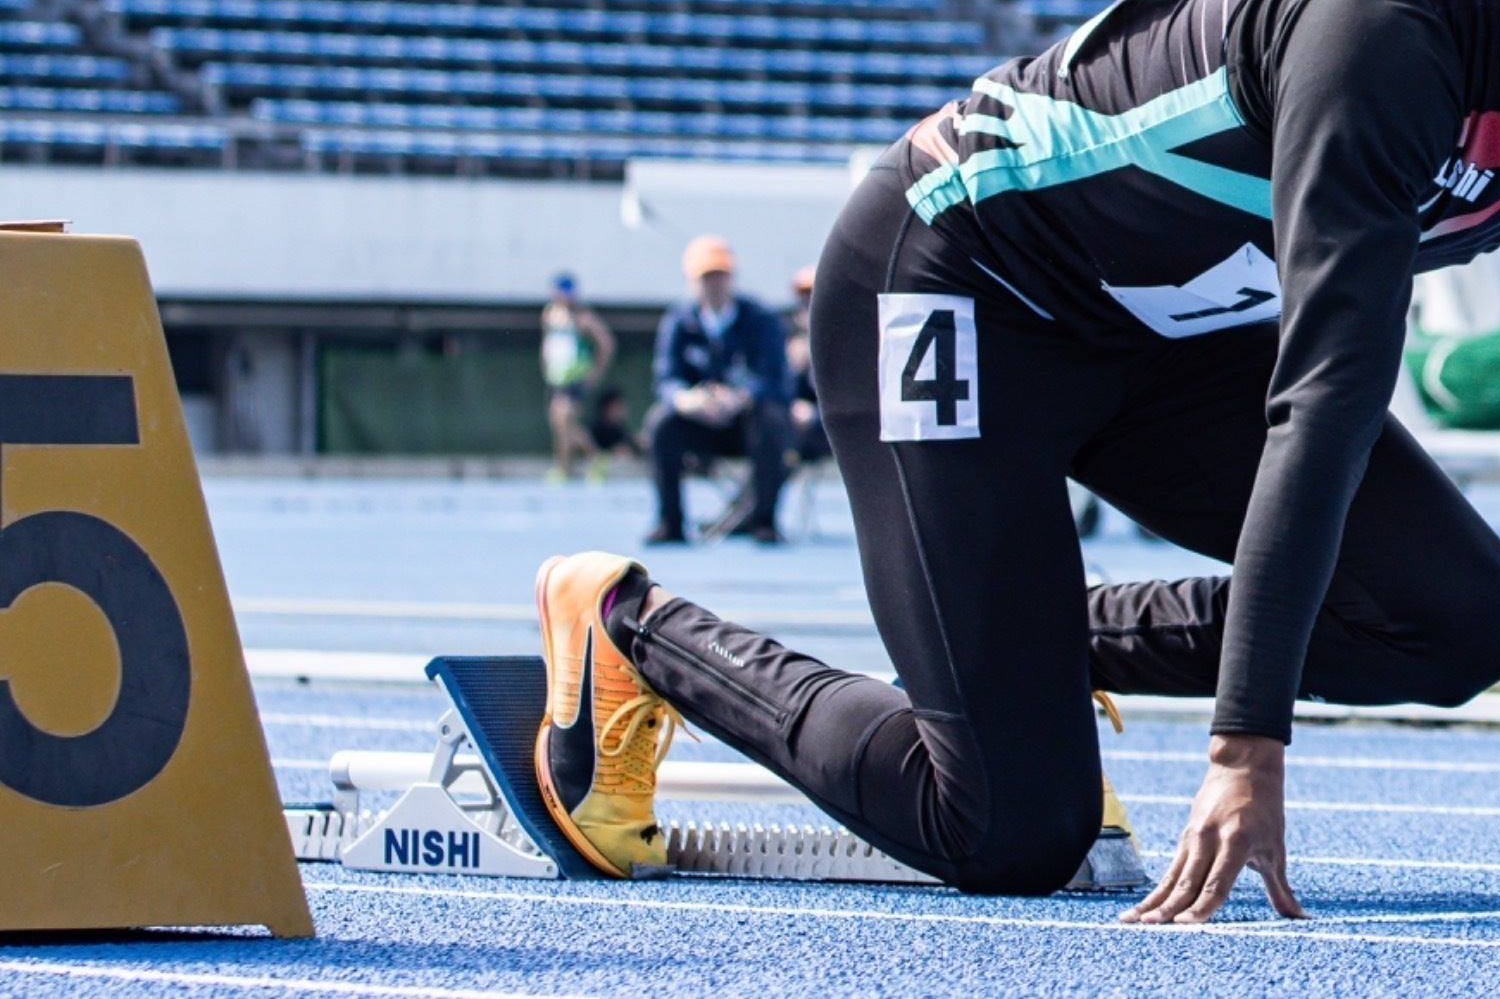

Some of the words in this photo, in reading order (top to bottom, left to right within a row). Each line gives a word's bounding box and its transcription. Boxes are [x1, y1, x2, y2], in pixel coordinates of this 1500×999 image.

[901, 309, 969, 426] 4
[0, 374, 192, 807] 5
[384, 828, 480, 868] NISHI
